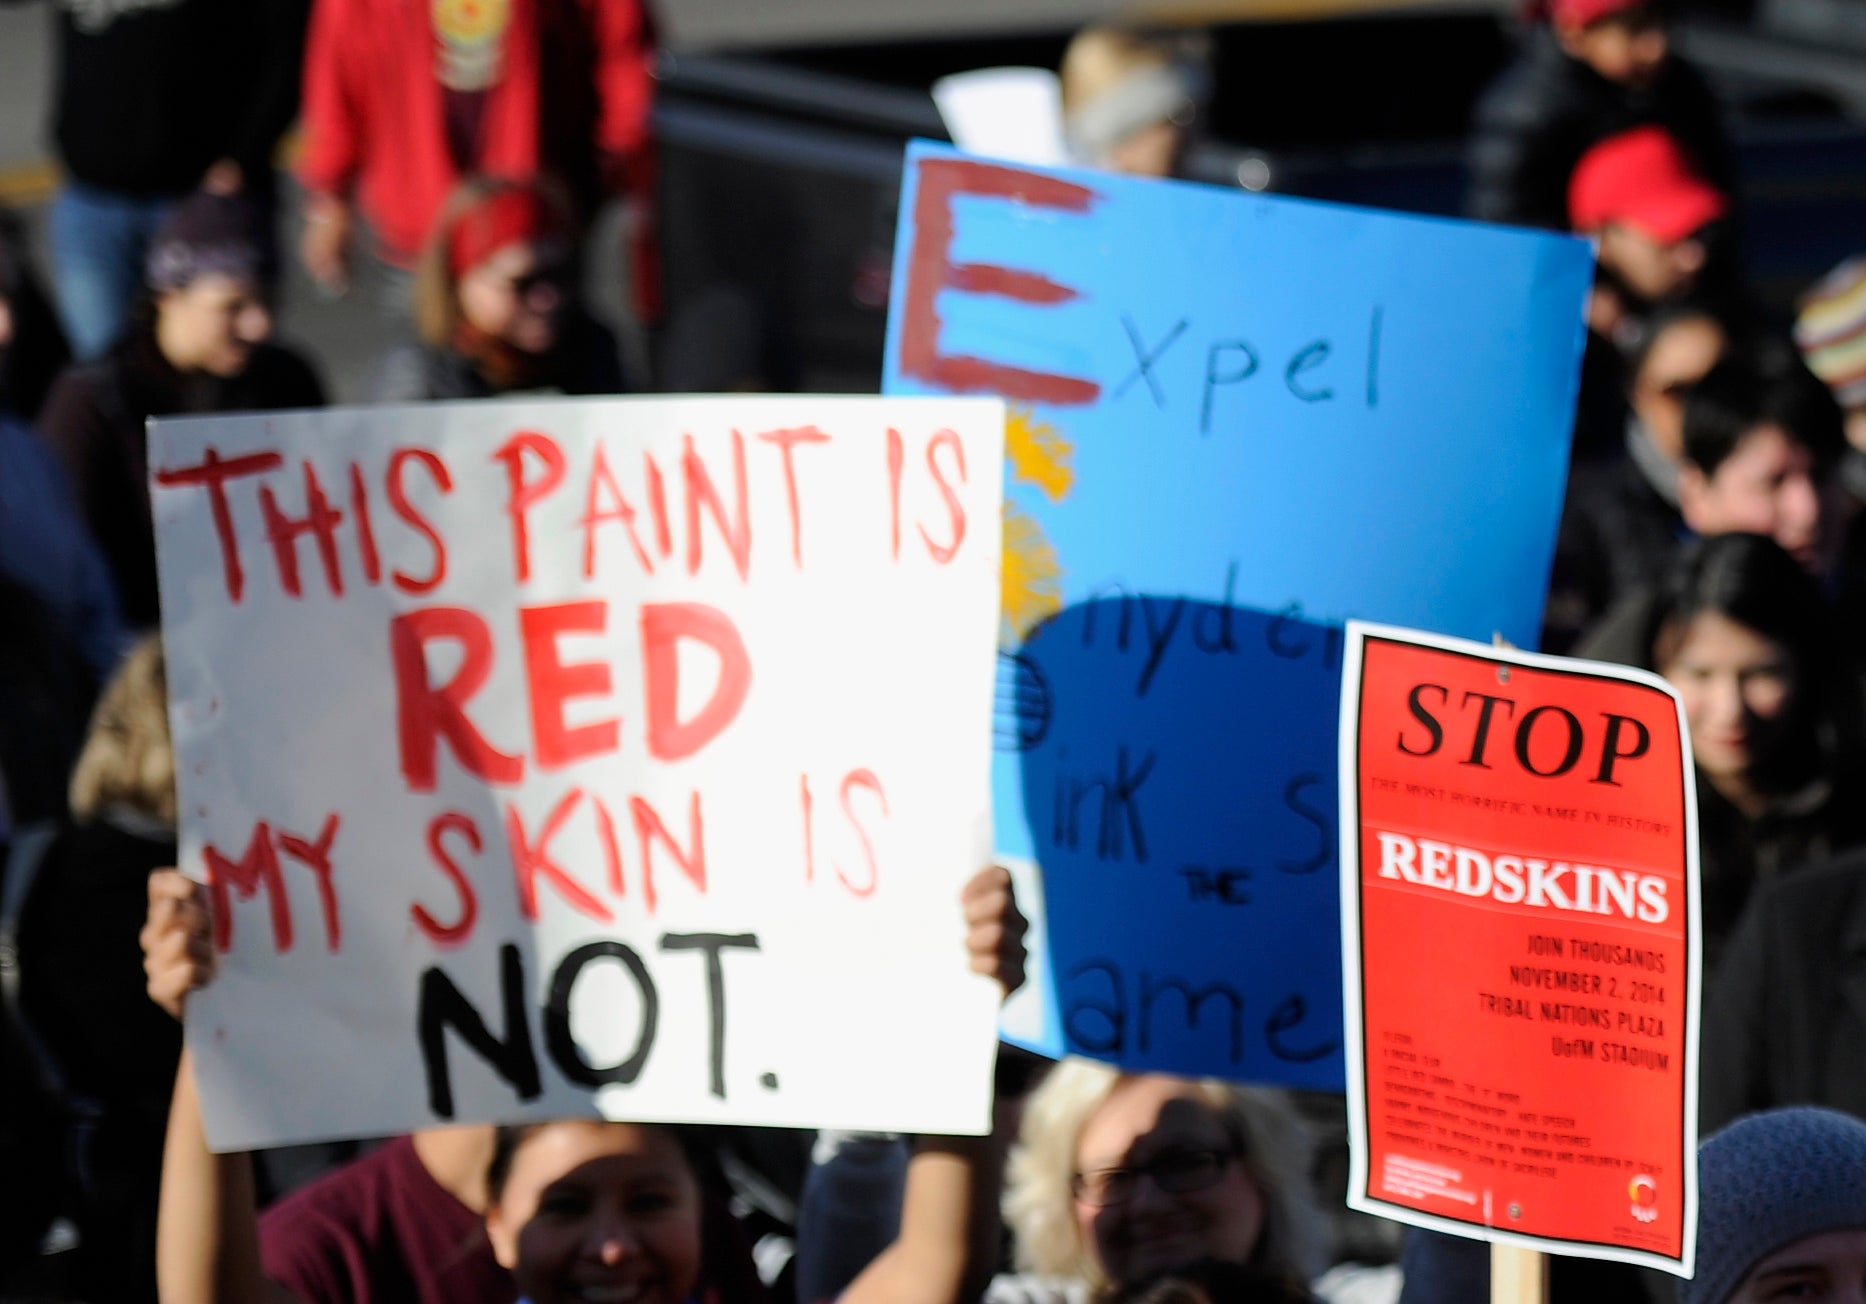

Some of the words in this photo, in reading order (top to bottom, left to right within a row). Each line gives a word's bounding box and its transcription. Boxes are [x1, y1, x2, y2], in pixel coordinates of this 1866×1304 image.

[900, 158, 1386, 436] Expel
[156, 446, 452, 602] THIS
[494, 426, 832, 584] PAINT
[886, 427, 968, 564] IS
[391, 600, 752, 792] RED
[1397, 683, 1650, 787] STOP
[201, 812, 342, 953] MY
[411, 786, 707, 944] SKIN
[801, 767, 890, 898] IS
[1377, 831, 1669, 924] REDSKINS
[1510, 965, 1601, 996] NOVEMBER
[1631, 980, 1665, 1006] 2014
[1528, 935, 1563, 958] JOIN
[1570, 938, 1665, 974] THOUSANDS
[416, 932, 779, 1120] NOT.
[1479, 992, 1533, 1020] TRIBAL
[1540, 1001, 1611, 1030] NATIONS
[1617, 1011, 1664, 1037] PLAZA
[1601, 1042, 1669, 1071] STADIUM
